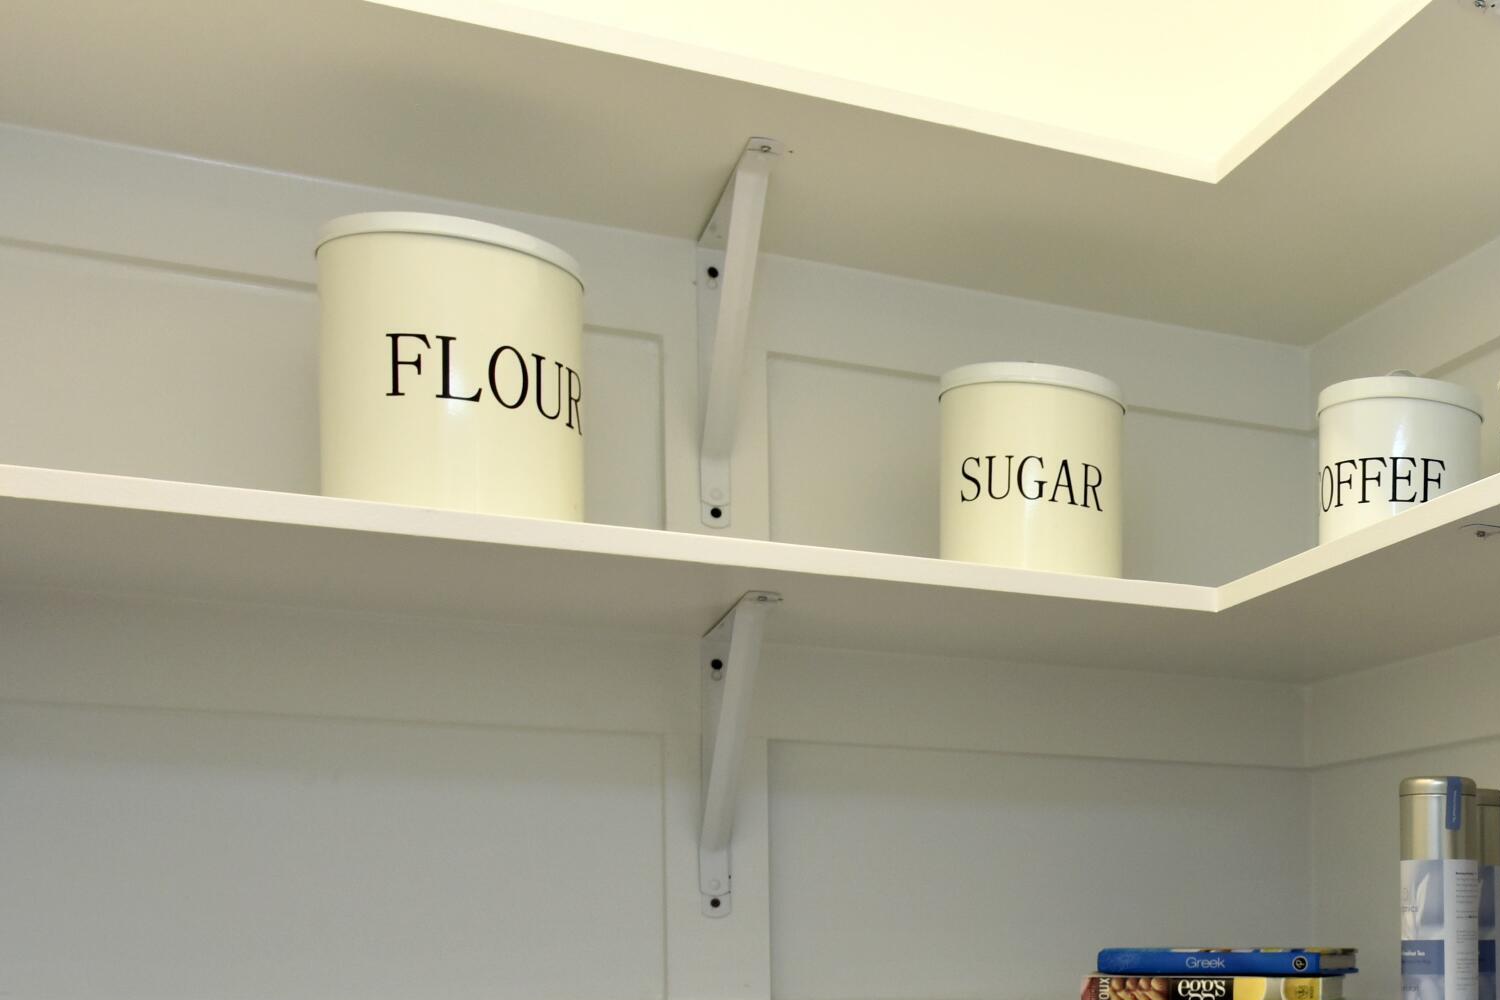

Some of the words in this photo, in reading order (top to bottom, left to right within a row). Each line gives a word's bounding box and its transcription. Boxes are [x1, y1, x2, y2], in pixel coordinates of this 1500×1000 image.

[385, 332, 583, 436] FLOUR
[960, 455, 1104, 512] SUGAR
[1320, 457, 1446, 512] OFFEE
[1186, 957, 1225, 969] Greek
